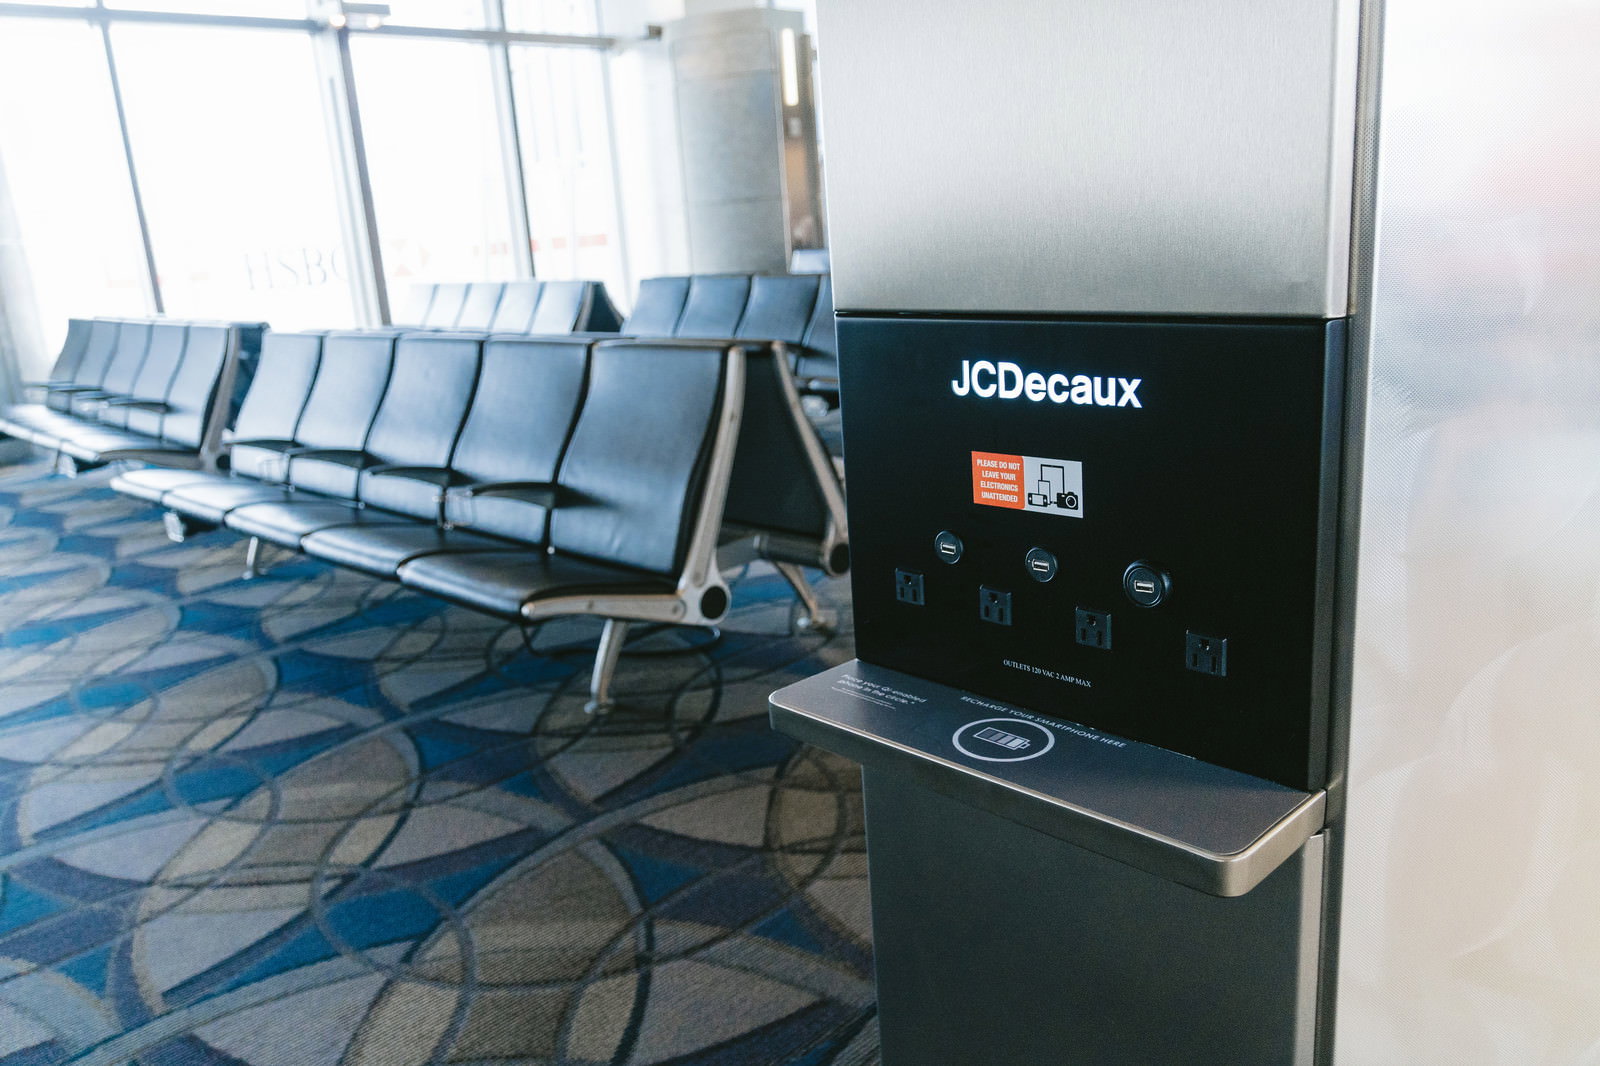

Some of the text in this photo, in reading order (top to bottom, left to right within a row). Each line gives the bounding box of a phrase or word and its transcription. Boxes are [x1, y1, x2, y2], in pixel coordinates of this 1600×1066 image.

[951, 359, 1143, 409] JCDecaux
[976, 459, 1021, 471] PLEASE DO NOT
[981, 470, 1016, 481] LEAVE YOUR
[980, 481, 1019, 492] ELECTRONICS
[981, 491, 1018, 503] UNATTENDED
[1003, 659, 1092, 688] OUTLETS 120 VAC 2 AMP MAX
[960, 696, 1128, 749] RECHARGE YOUR SMARTPHONE HERE
